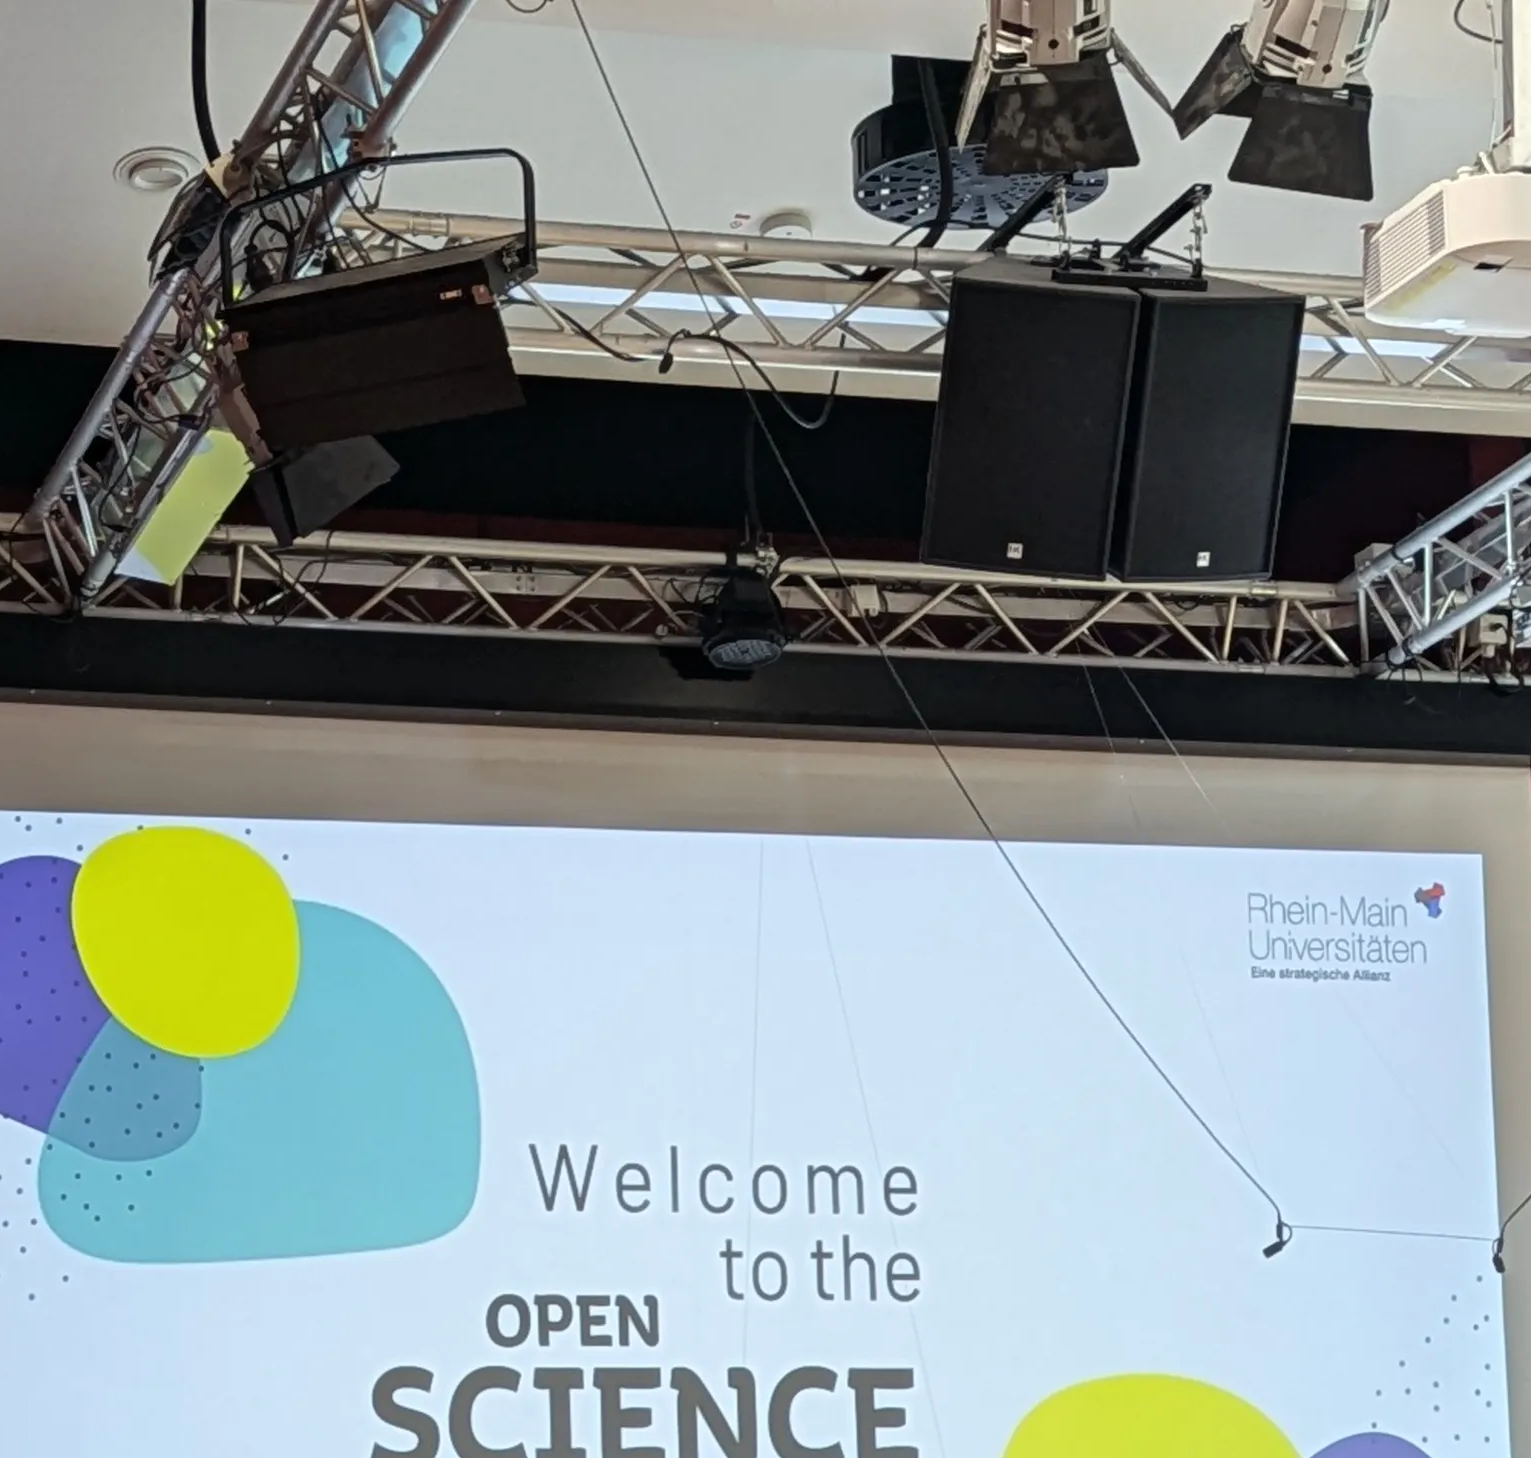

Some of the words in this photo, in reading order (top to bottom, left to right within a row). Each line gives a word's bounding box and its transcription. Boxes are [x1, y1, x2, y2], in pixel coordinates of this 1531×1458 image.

[1247, 892, 1408, 928] Rhein-Main
[1248, 929, 1428, 964] Universitäten
[1250, 965, 1276, 980] Eine
[1278, 967, 1350, 983] strategische
[1352, 969, 1392, 982] Allianz
[528, 1143, 919, 1216] Welcome
[719, 1238, 788, 1302] to
[810, 1234, 921, 1302] the
[485, 1293, 660, 1348] OPEN
